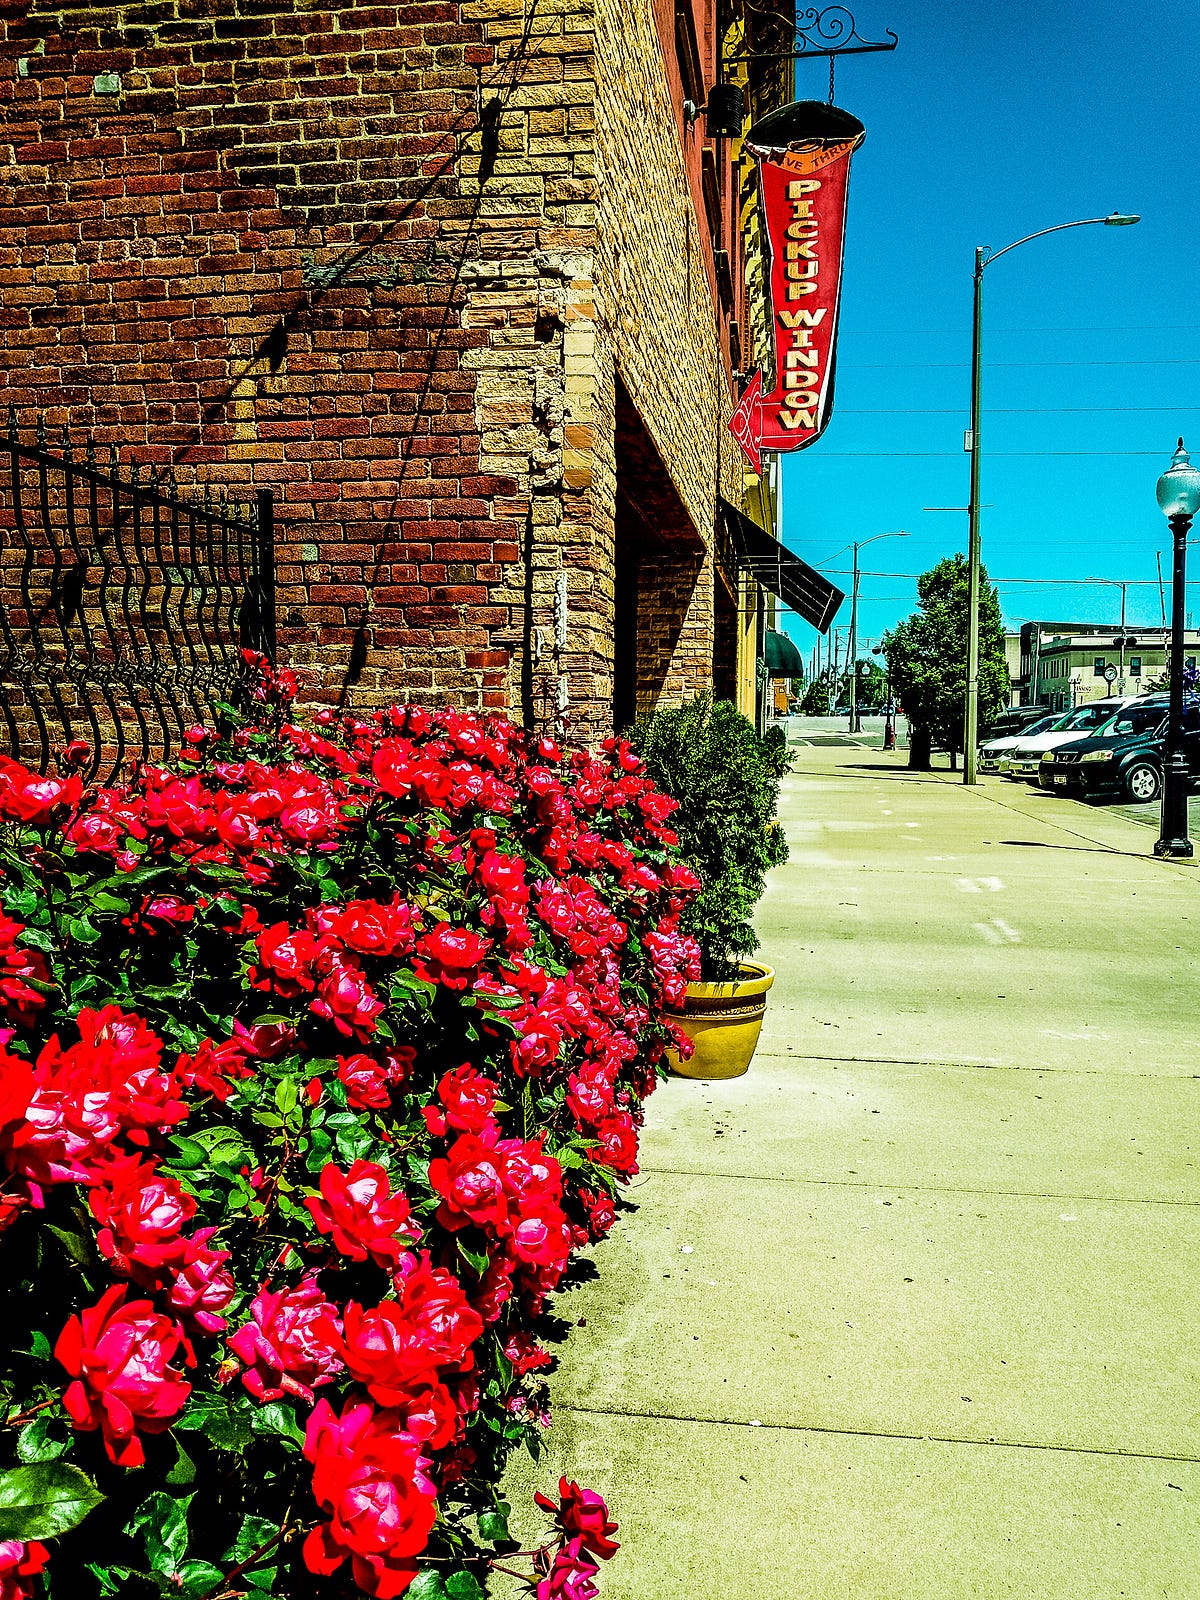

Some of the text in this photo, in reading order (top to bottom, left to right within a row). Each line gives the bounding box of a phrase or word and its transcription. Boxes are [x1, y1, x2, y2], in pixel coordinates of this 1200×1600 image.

[811, 142, 849, 166] THRU
[778, 179, 828, 429] PICKUP WINDOW
